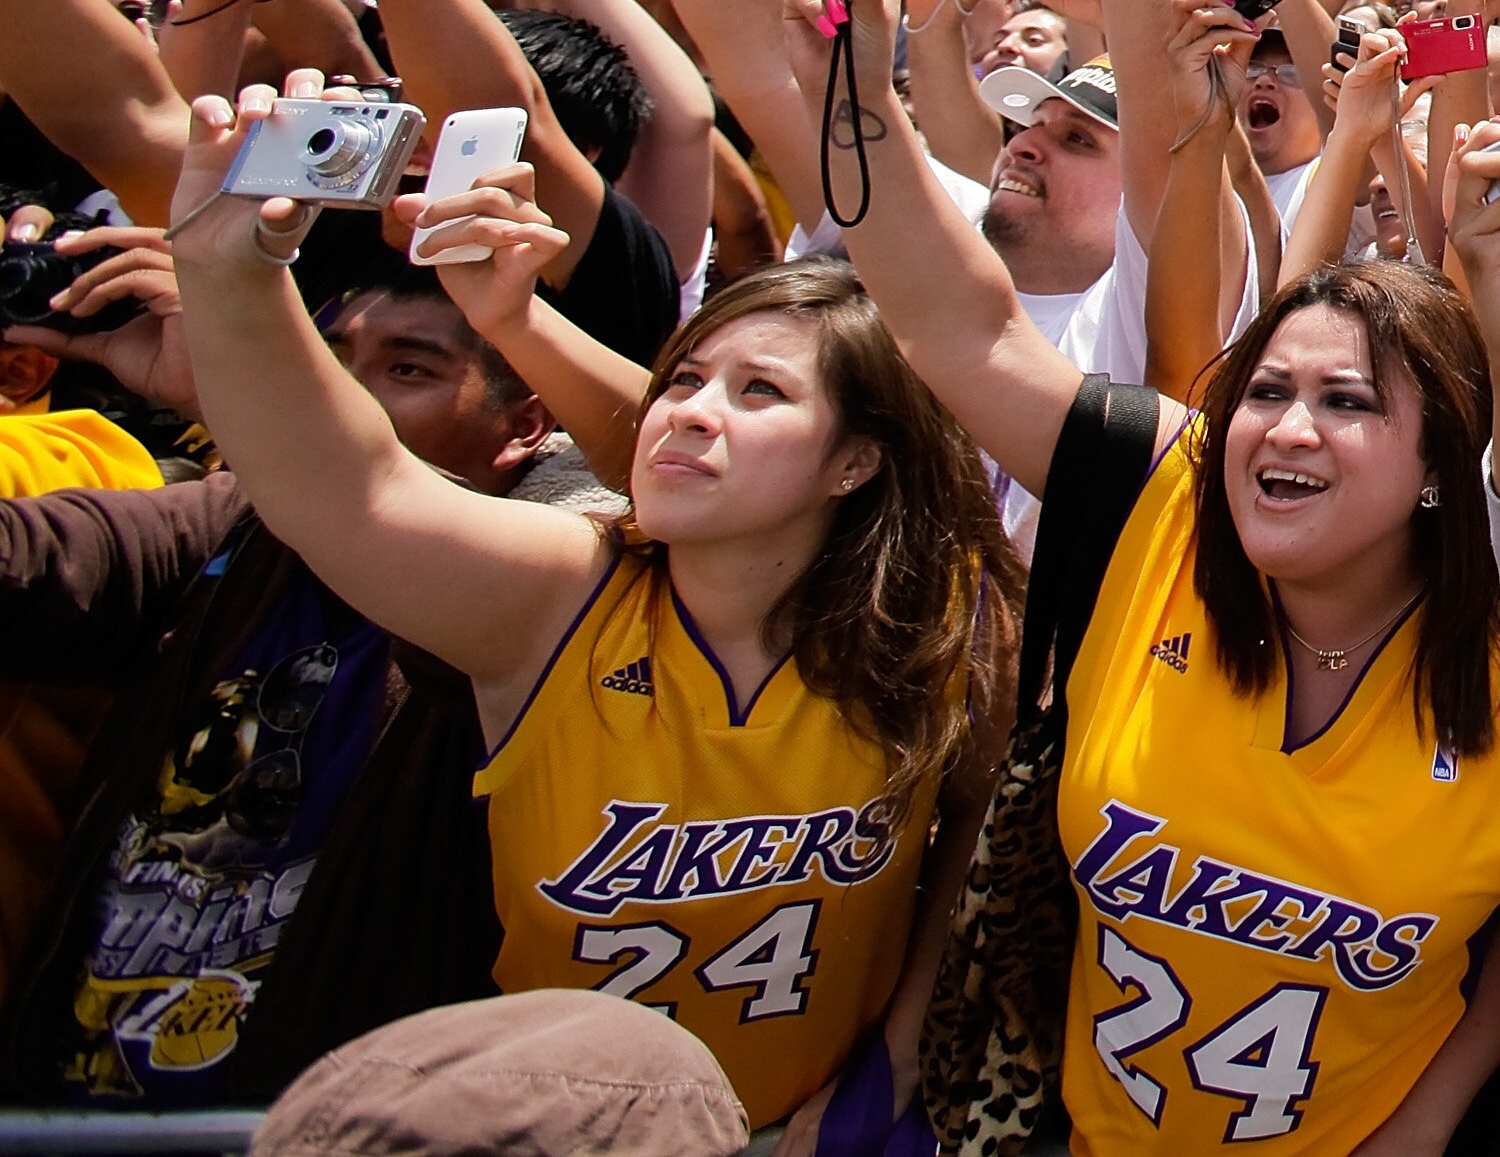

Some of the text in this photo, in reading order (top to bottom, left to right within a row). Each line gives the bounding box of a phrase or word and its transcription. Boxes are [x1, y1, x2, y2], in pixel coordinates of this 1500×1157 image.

[1150, 644, 1188, 675] adidas
[1434, 767, 1450, 778] NBA
[535, 799, 900, 919] LAKERS
[1069, 797, 1440, 993] LAKERS
[572, 898, 823, 1026] 24
[1092, 921, 1329, 1144] 24
